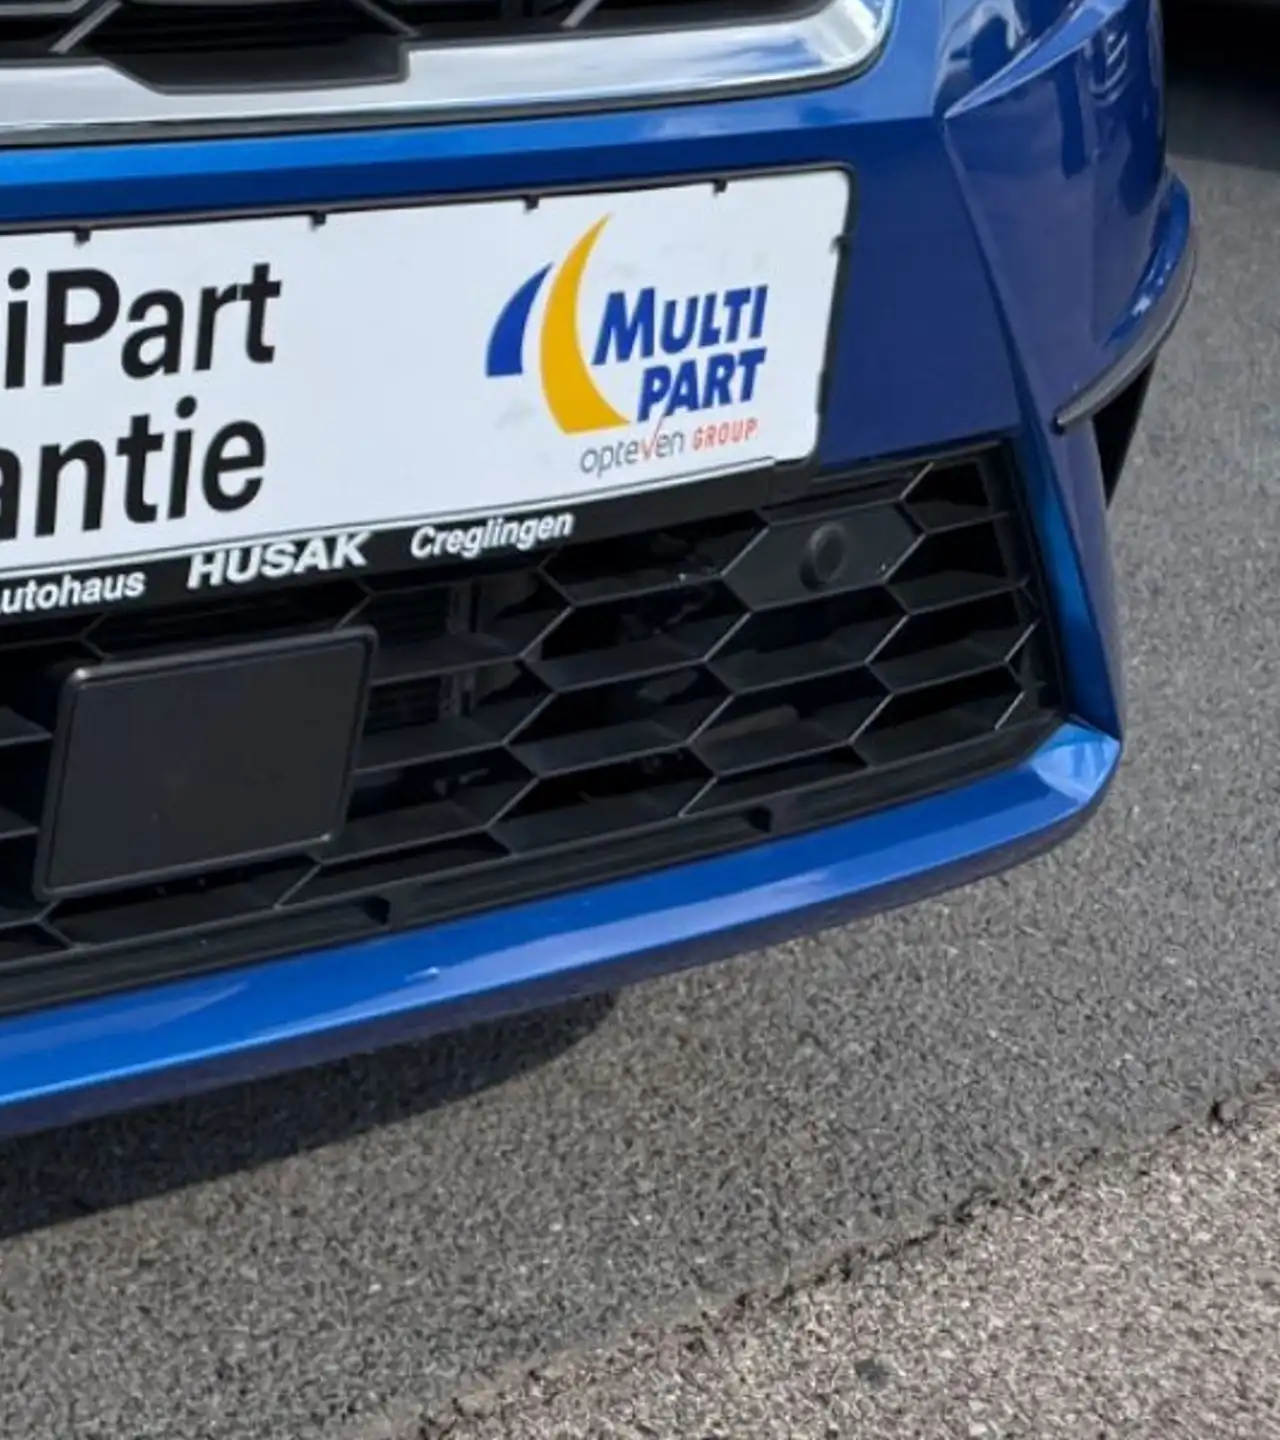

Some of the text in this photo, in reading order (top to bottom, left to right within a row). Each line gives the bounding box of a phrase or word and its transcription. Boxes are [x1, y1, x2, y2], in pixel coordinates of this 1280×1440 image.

[590, 284, 769, 366] MULTI
[637, 347, 768, 423] PART
[579, 417, 758, 478] opteven GROUP
[187, 532, 370, 591] HUSAK
[409, 512, 575, 559] Creglingen
